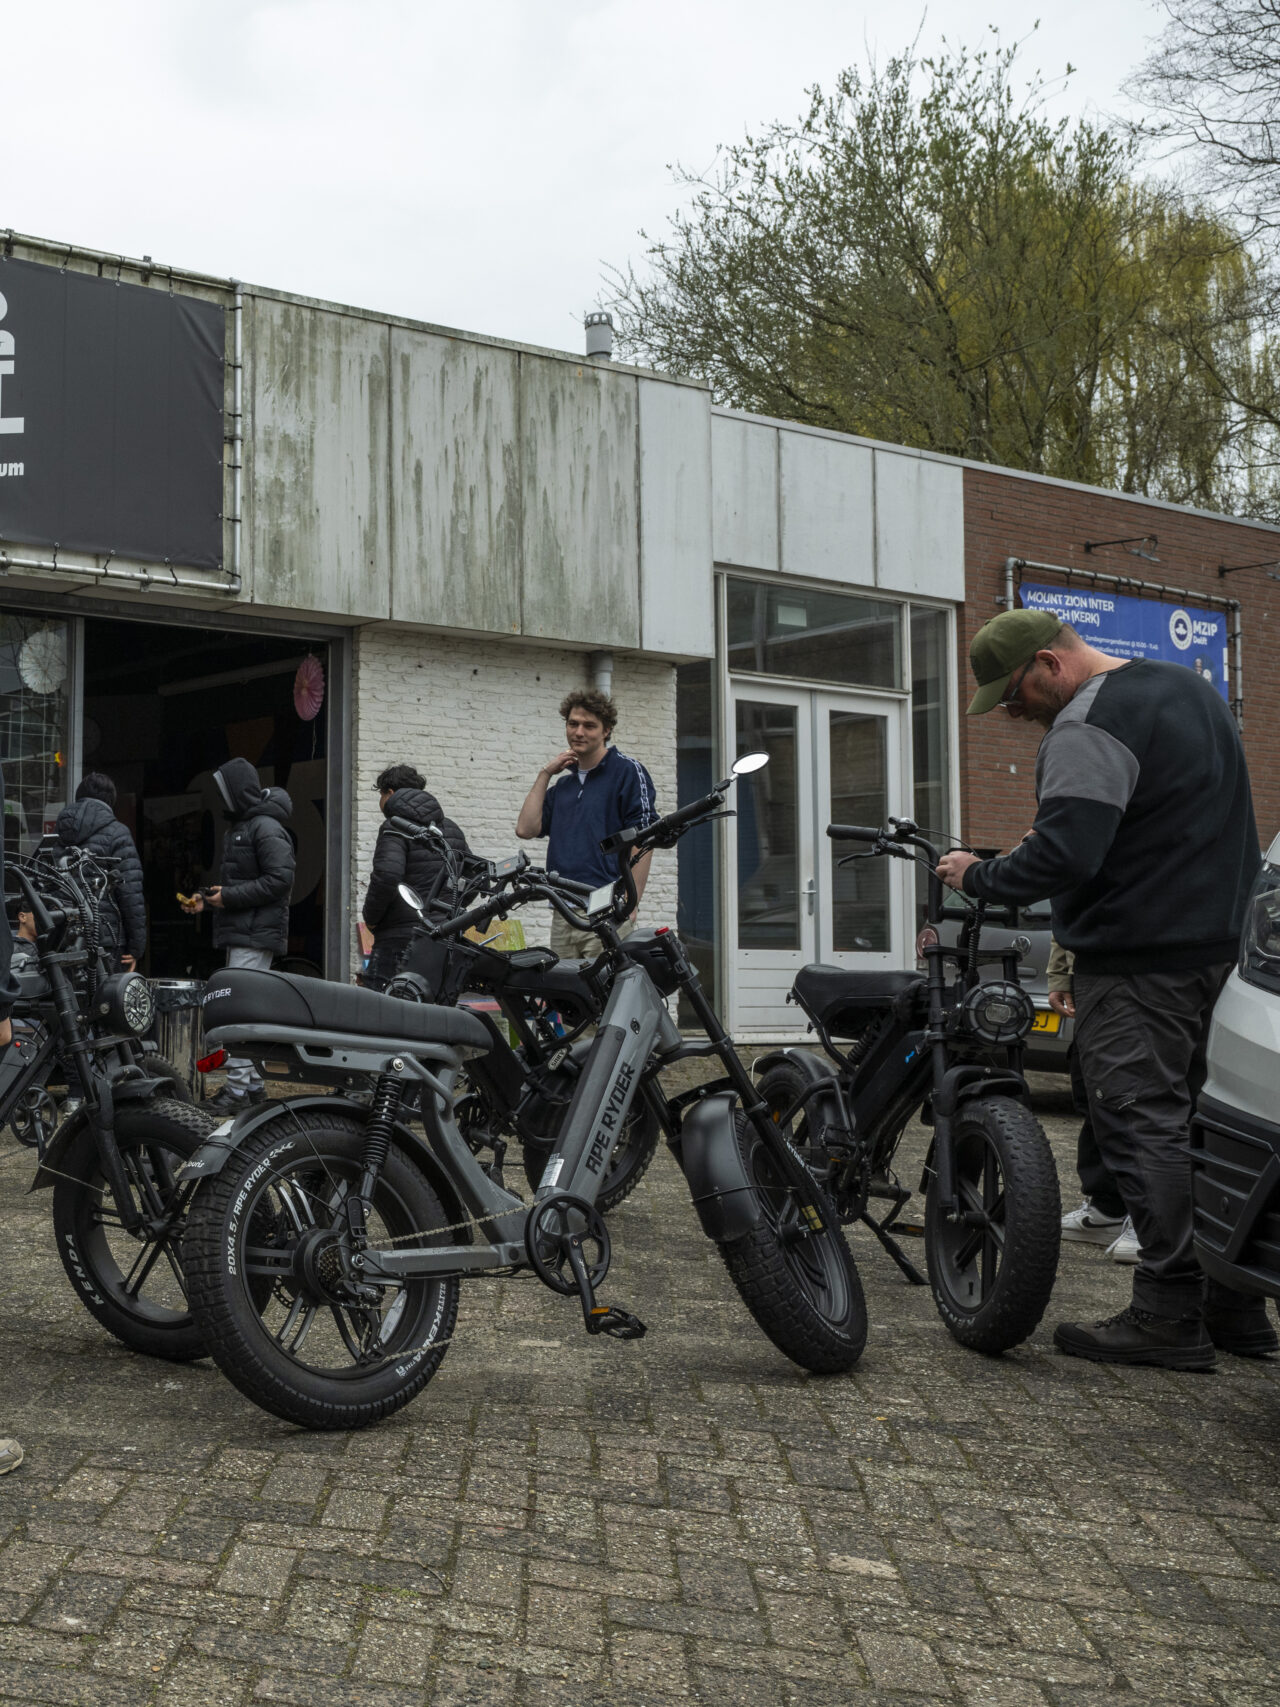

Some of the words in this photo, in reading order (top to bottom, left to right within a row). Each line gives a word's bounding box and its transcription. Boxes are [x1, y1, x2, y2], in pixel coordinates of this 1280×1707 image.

[1027, 590, 1063, 605] MOUNT
[1064, 594, 1088, 609] ZION
[1088, 598, 1115, 612] INTER
[1071, 609, 1100, 627] (KERK)
[1193, 620, 1218, 636] MZIP
[207, 987, 232, 1002] RYDER
[585, 1131, 610, 1176] APE
[601, 1061, 636, 1132] RYDER
[245, 1157, 272, 1192] RYDER
[65, 1234, 105, 1305] KENDA
